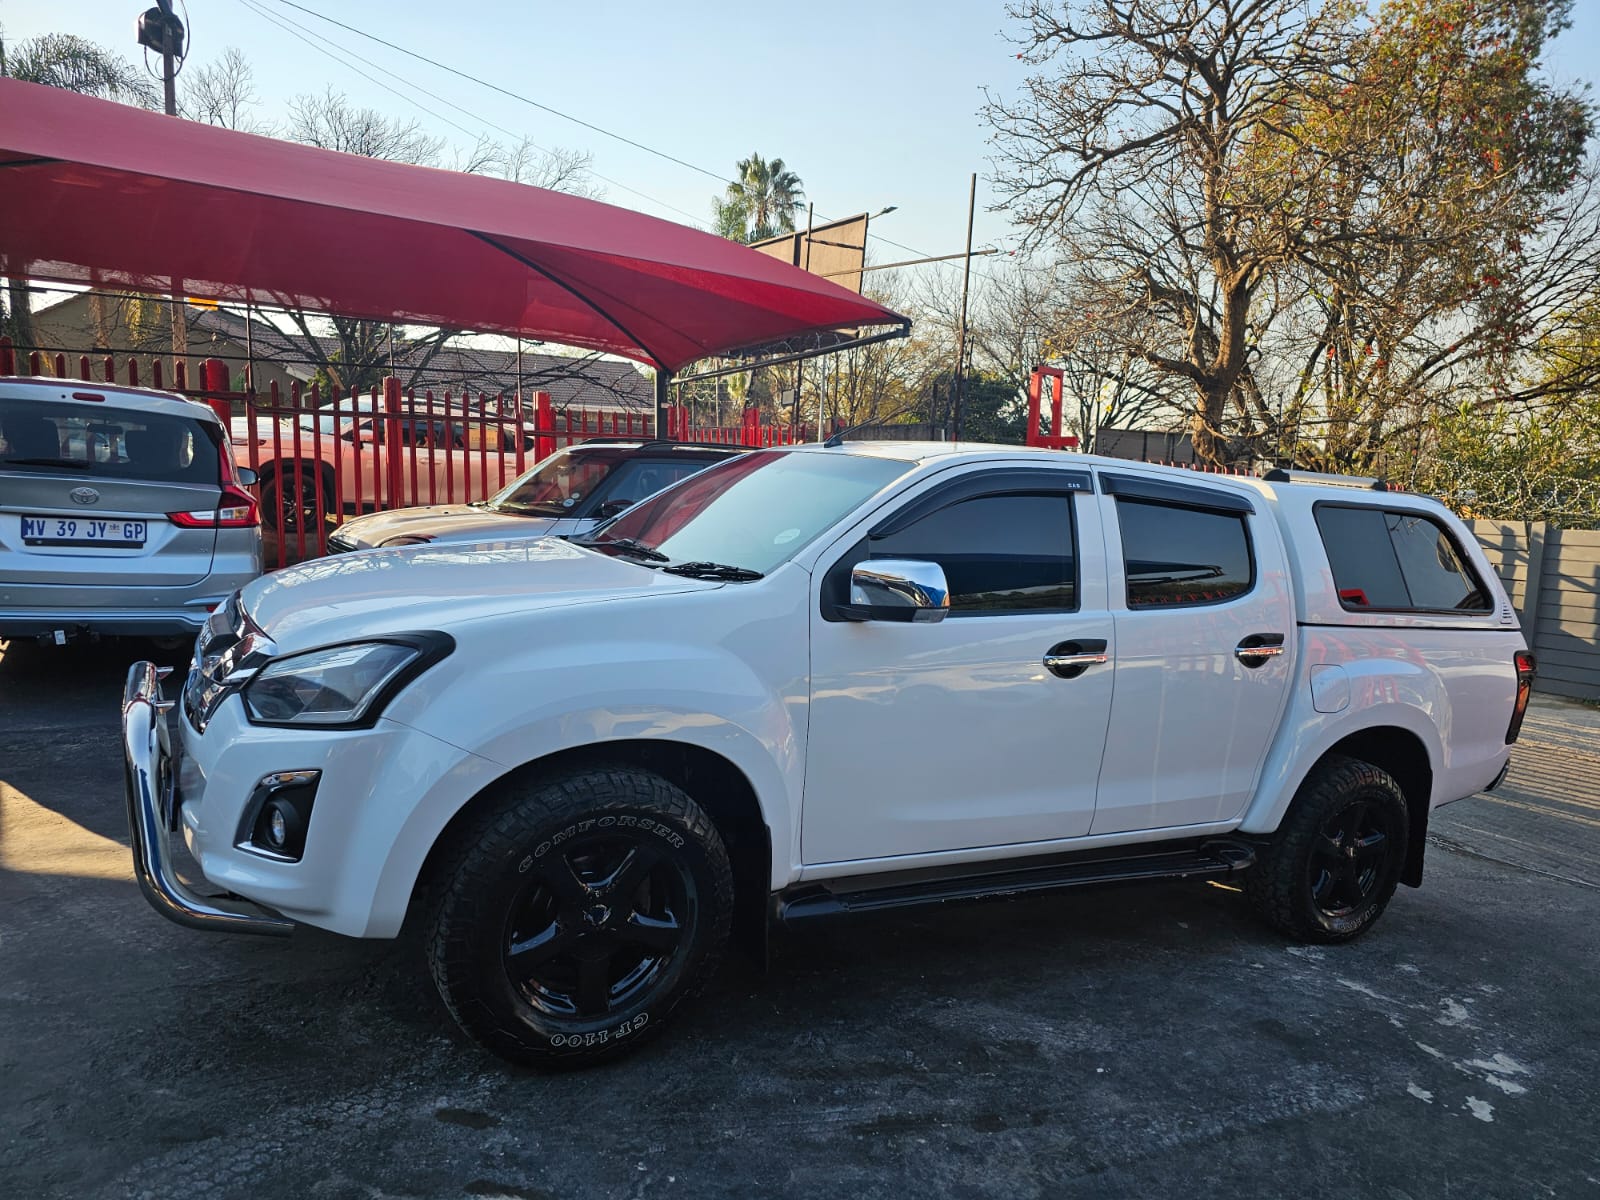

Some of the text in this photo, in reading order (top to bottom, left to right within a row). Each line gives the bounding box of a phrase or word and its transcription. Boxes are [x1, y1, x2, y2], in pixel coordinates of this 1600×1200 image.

[25, 519, 143, 540] MV 39 JY GP
[518, 815, 685, 873] COMFORSER
